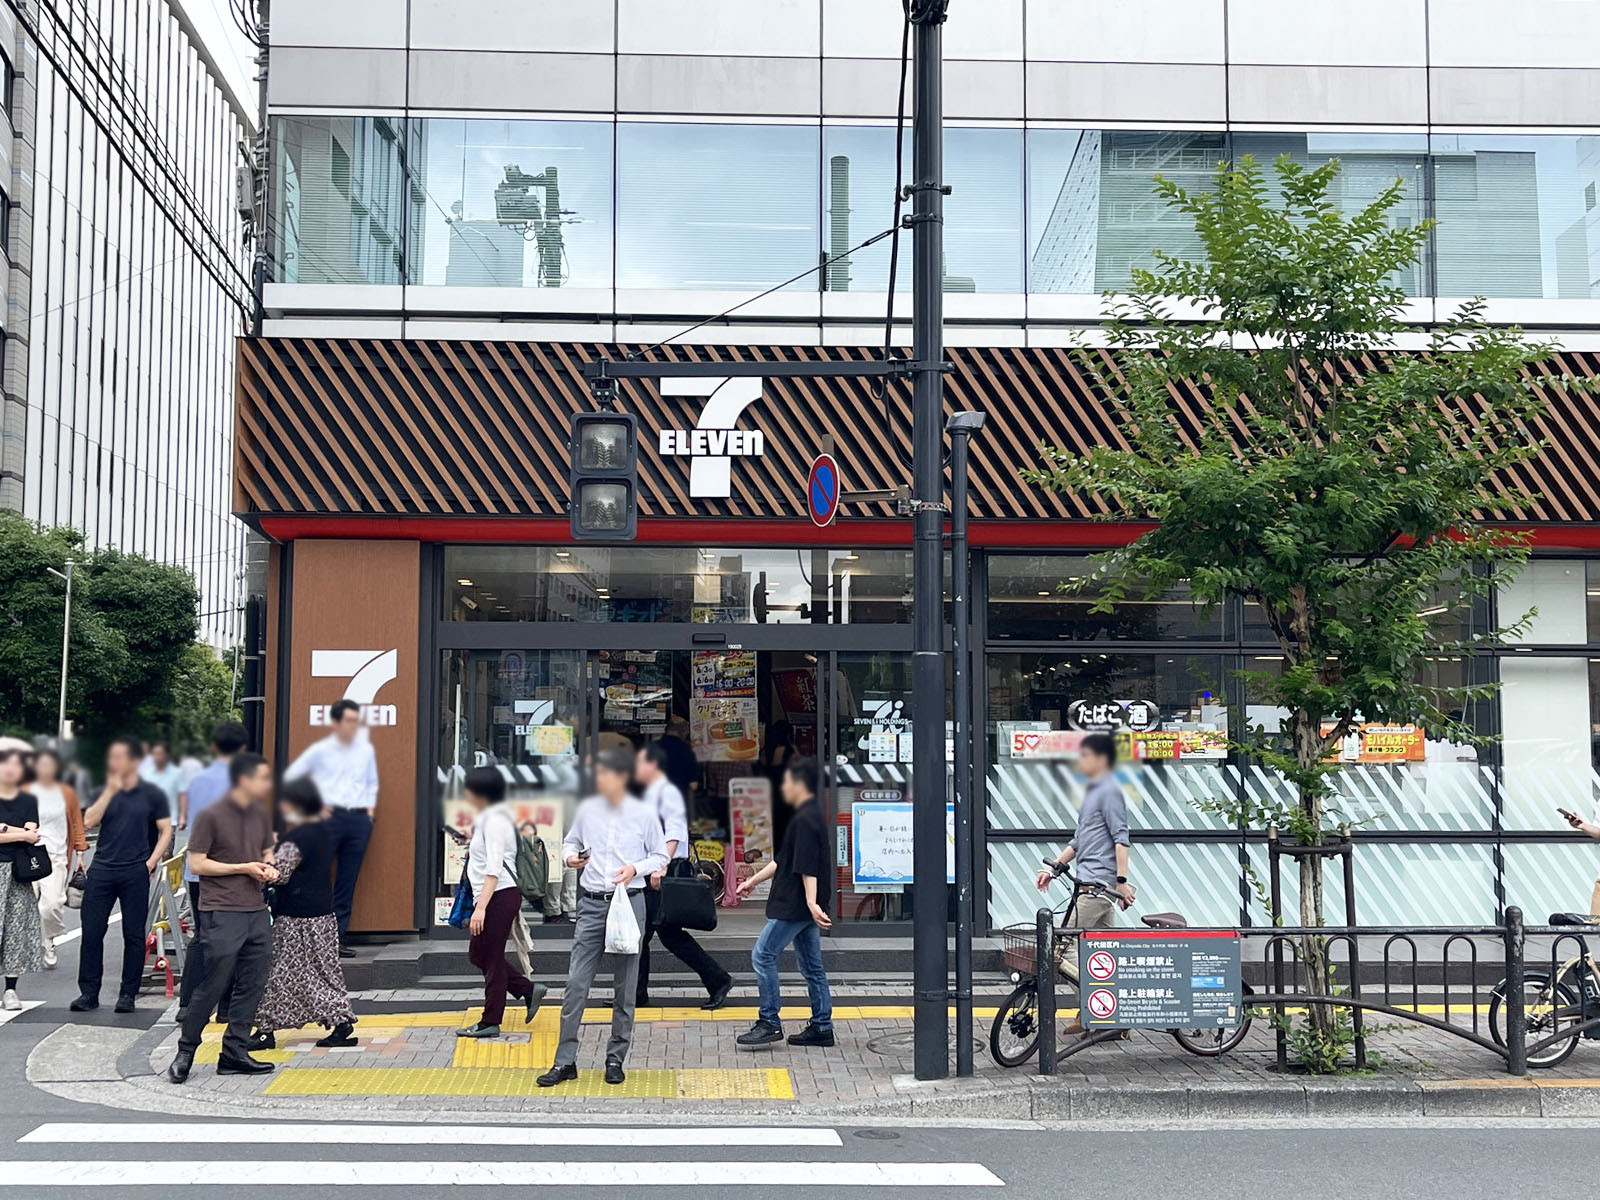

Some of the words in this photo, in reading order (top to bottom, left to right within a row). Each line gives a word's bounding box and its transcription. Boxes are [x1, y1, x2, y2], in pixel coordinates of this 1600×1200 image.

[660, 376, 763, 497] 7
[311, 648, 397, 728] 7
[309, 704, 397, 726] ELEn
[1077, 703, 1123, 727] たばこ
[1128, 704, 1149, 725] 酒
[1365, 734, 1420, 745] モバイルオーダー
